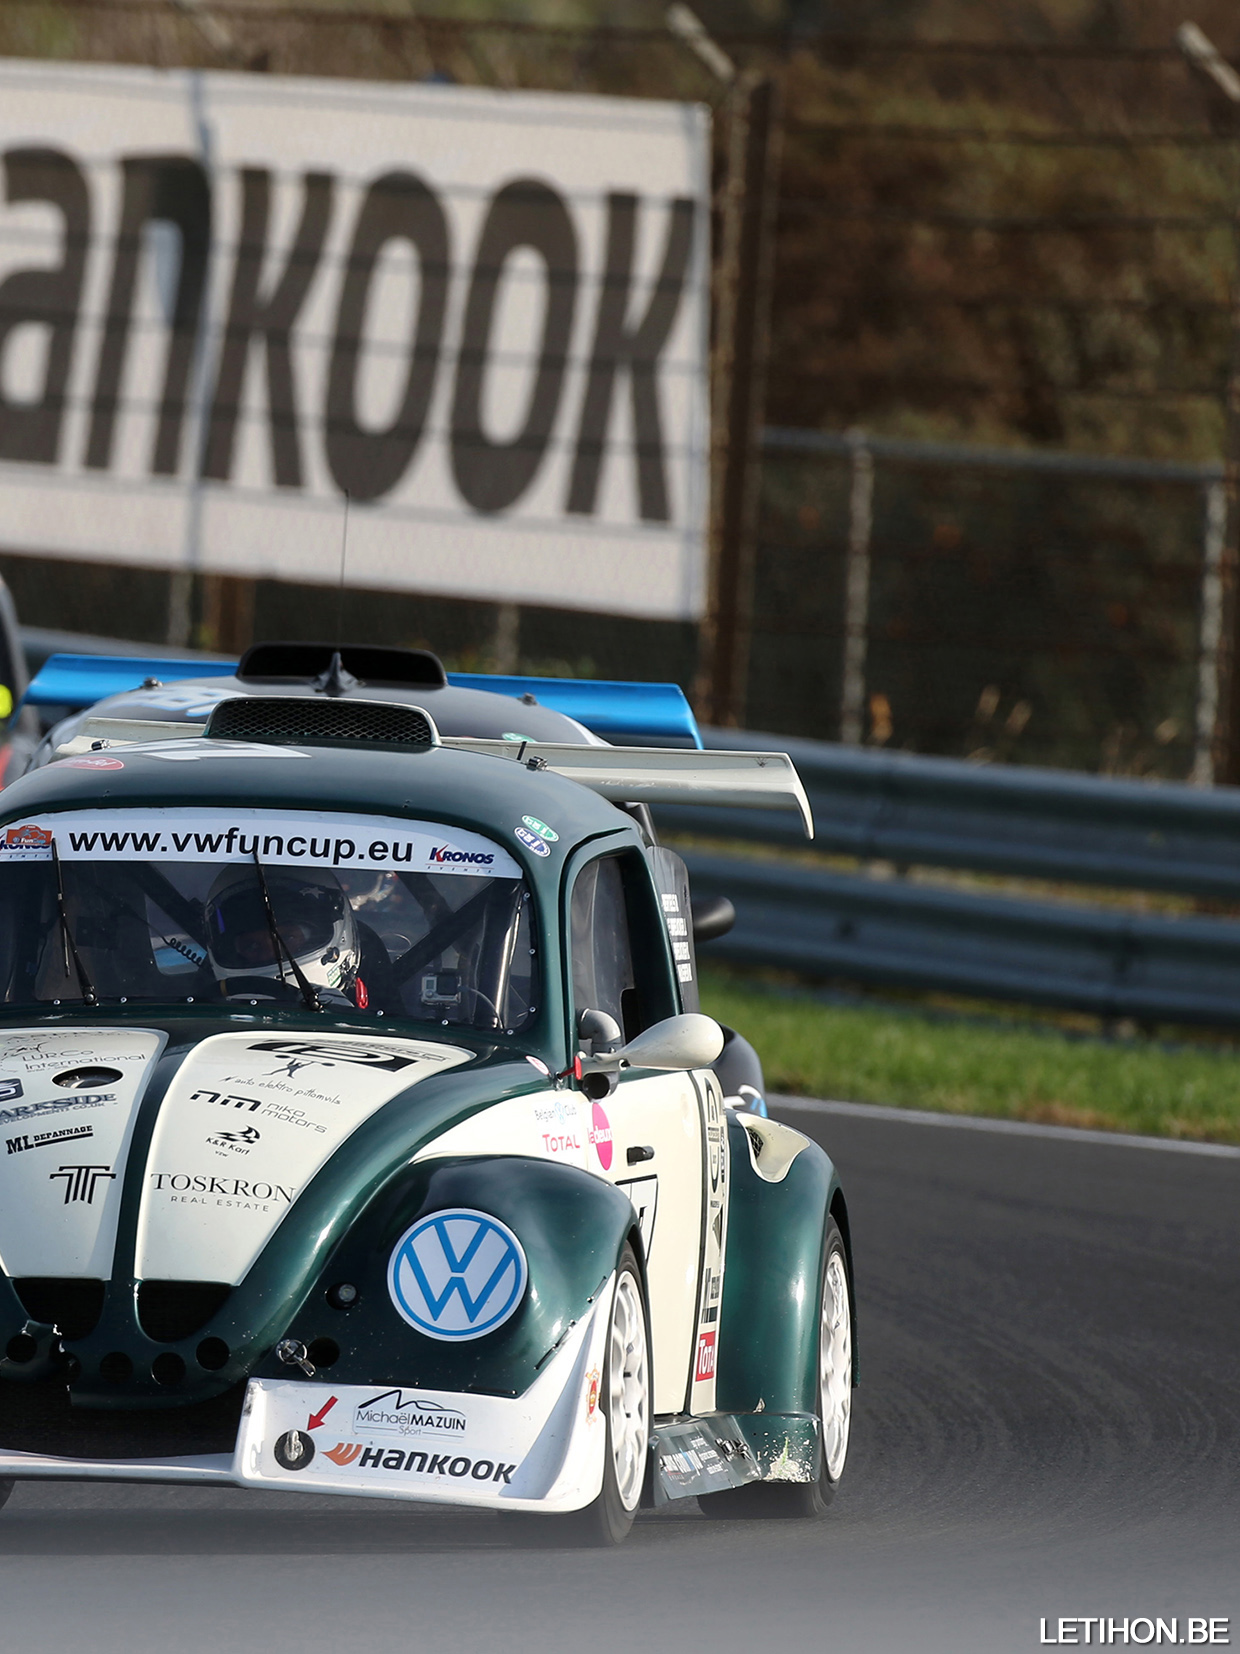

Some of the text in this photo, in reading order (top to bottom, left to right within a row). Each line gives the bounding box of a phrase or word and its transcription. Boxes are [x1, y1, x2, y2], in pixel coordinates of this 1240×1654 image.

[69, 827, 413, 866] www.vwfuncup.eu
[429, 844, 495, 864] KRONOS
[25, 1054, 146, 1070] International
[234, 1078, 255, 1086] auto
[258, 1080, 293, 1093] elektro
[261, 1109, 327, 1134] motors
[5, 1125, 93, 1155] ML DEPANNAGE
[205, 1137, 250, 1156] K&R Kart
[542, 1134, 581, 1153] TOTAL
[150, 1173, 297, 1203] TOSKRON
[171, 1195, 269, 1212] REAL ESTATE
[398, 1426, 422, 1436] Sport
